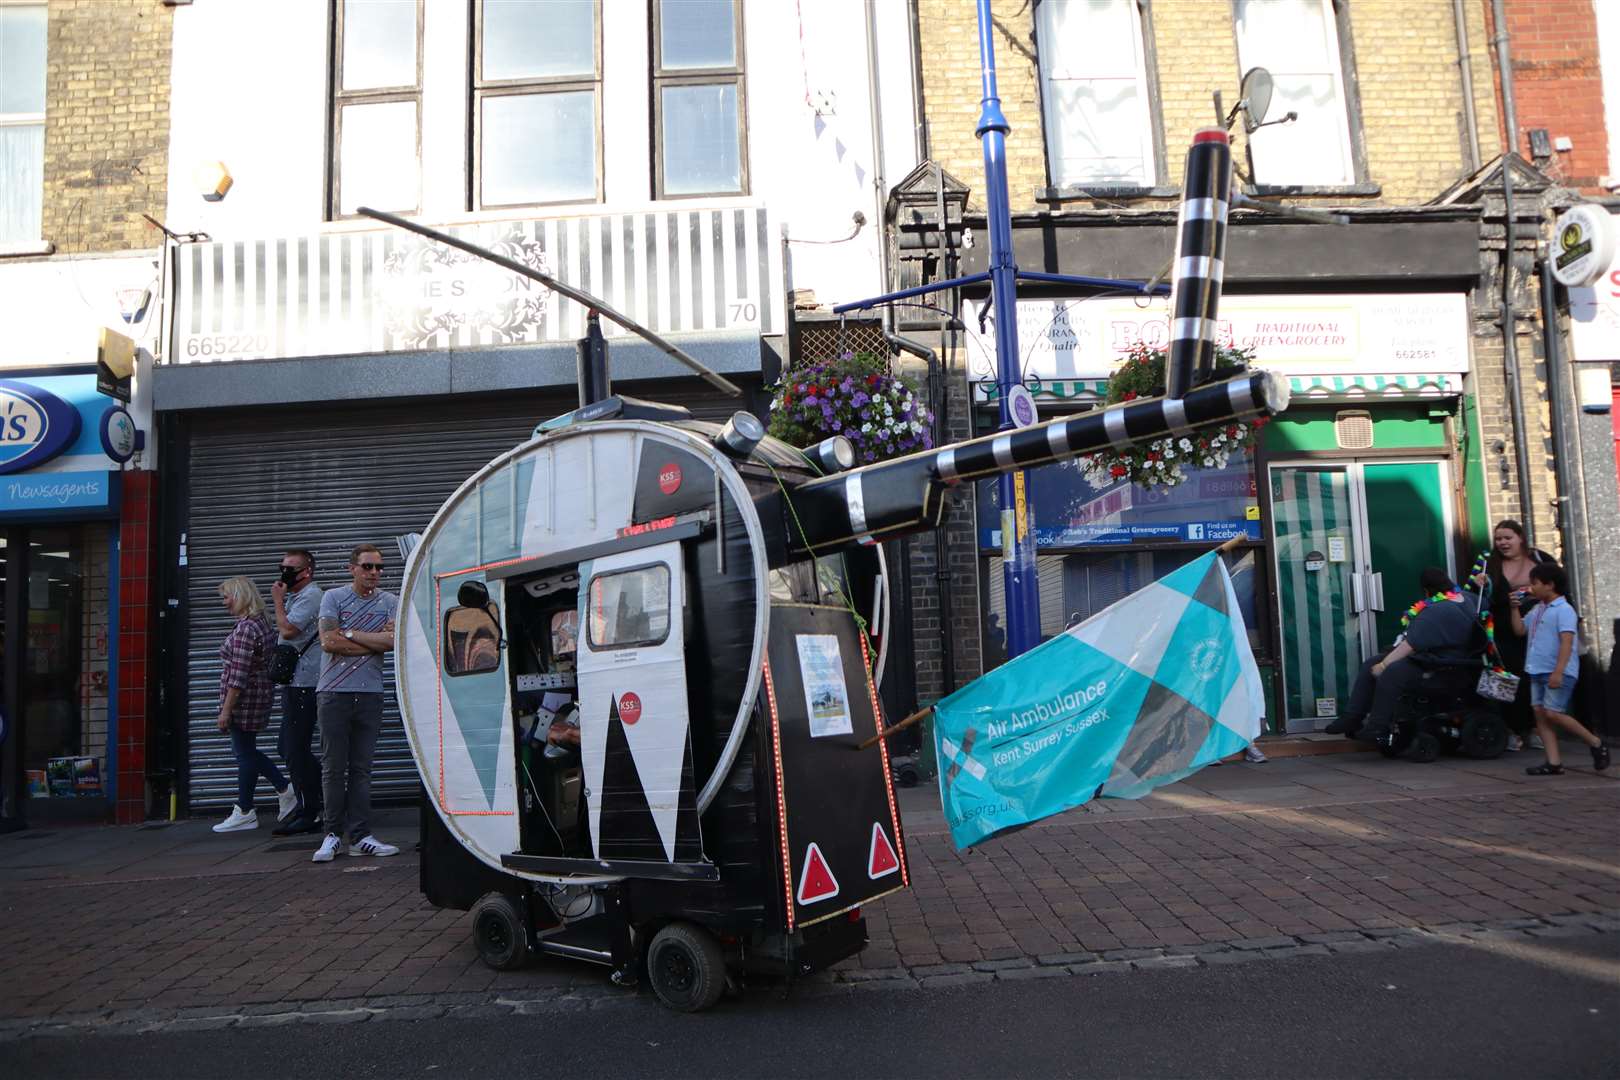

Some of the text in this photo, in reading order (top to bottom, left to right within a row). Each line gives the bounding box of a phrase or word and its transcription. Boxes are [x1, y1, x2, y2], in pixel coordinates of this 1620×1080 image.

[728, 303, 757, 322] 70
[1255, 322, 1339, 333] TRADITIONAL
[187, 335, 270, 357] 665220
[1241, 335, 1347, 346] GREENGROCERY
[9, 482, 99, 503] Newsagents
[620, 700, 634, 711] KSS
[987, 680, 1107, 742] Air Ambulance
[992, 708, 1110, 768] Kent Surrey Sussex
